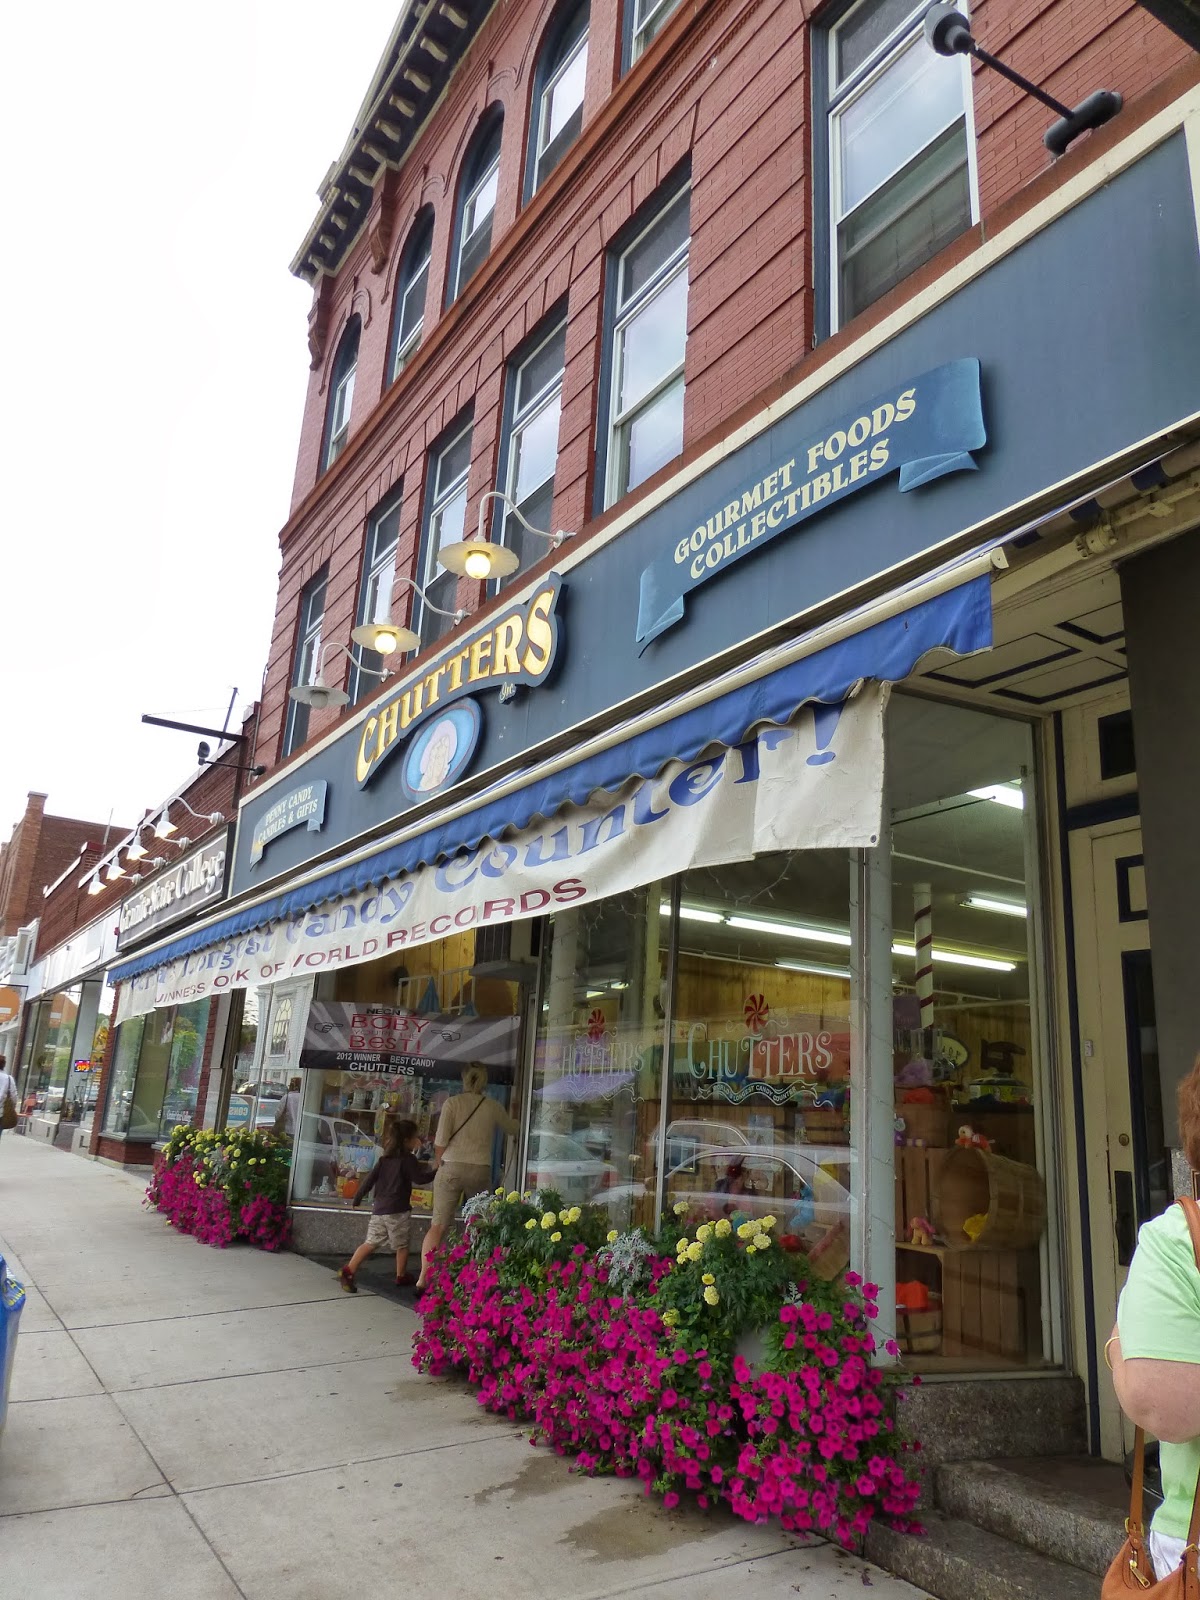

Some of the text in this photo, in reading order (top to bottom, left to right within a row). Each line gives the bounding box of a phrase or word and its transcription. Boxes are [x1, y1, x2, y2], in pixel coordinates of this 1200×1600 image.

[674, 388, 917, 565] GOURMET FOODS
[690, 439, 889, 580] COLLECTIBLES
[355, 588, 556, 783] CHUTTERS
[258, 799, 319, 845] CANDLES & GIFTS
[265, 785, 314, 826] PENNY CANDY
[175, 850, 226, 899] College
[155, 982, 206, 1003] UINNESS
[260, 962, 286, 978] OF
[387, 878, 587, 948] RECORDS
[336, 1052, 436, 1068] 2012 WINNER BEST CANDY
[349, 1062, 415, 1076] CHUTTERS
[687, 1023, 833, 1080] CHUTTERS
[733, 1086, 755, 1102] LONGEST
[755, 1085, 774, 1097] CANDY
[772, 1086, 797, 1102] COUNTER
